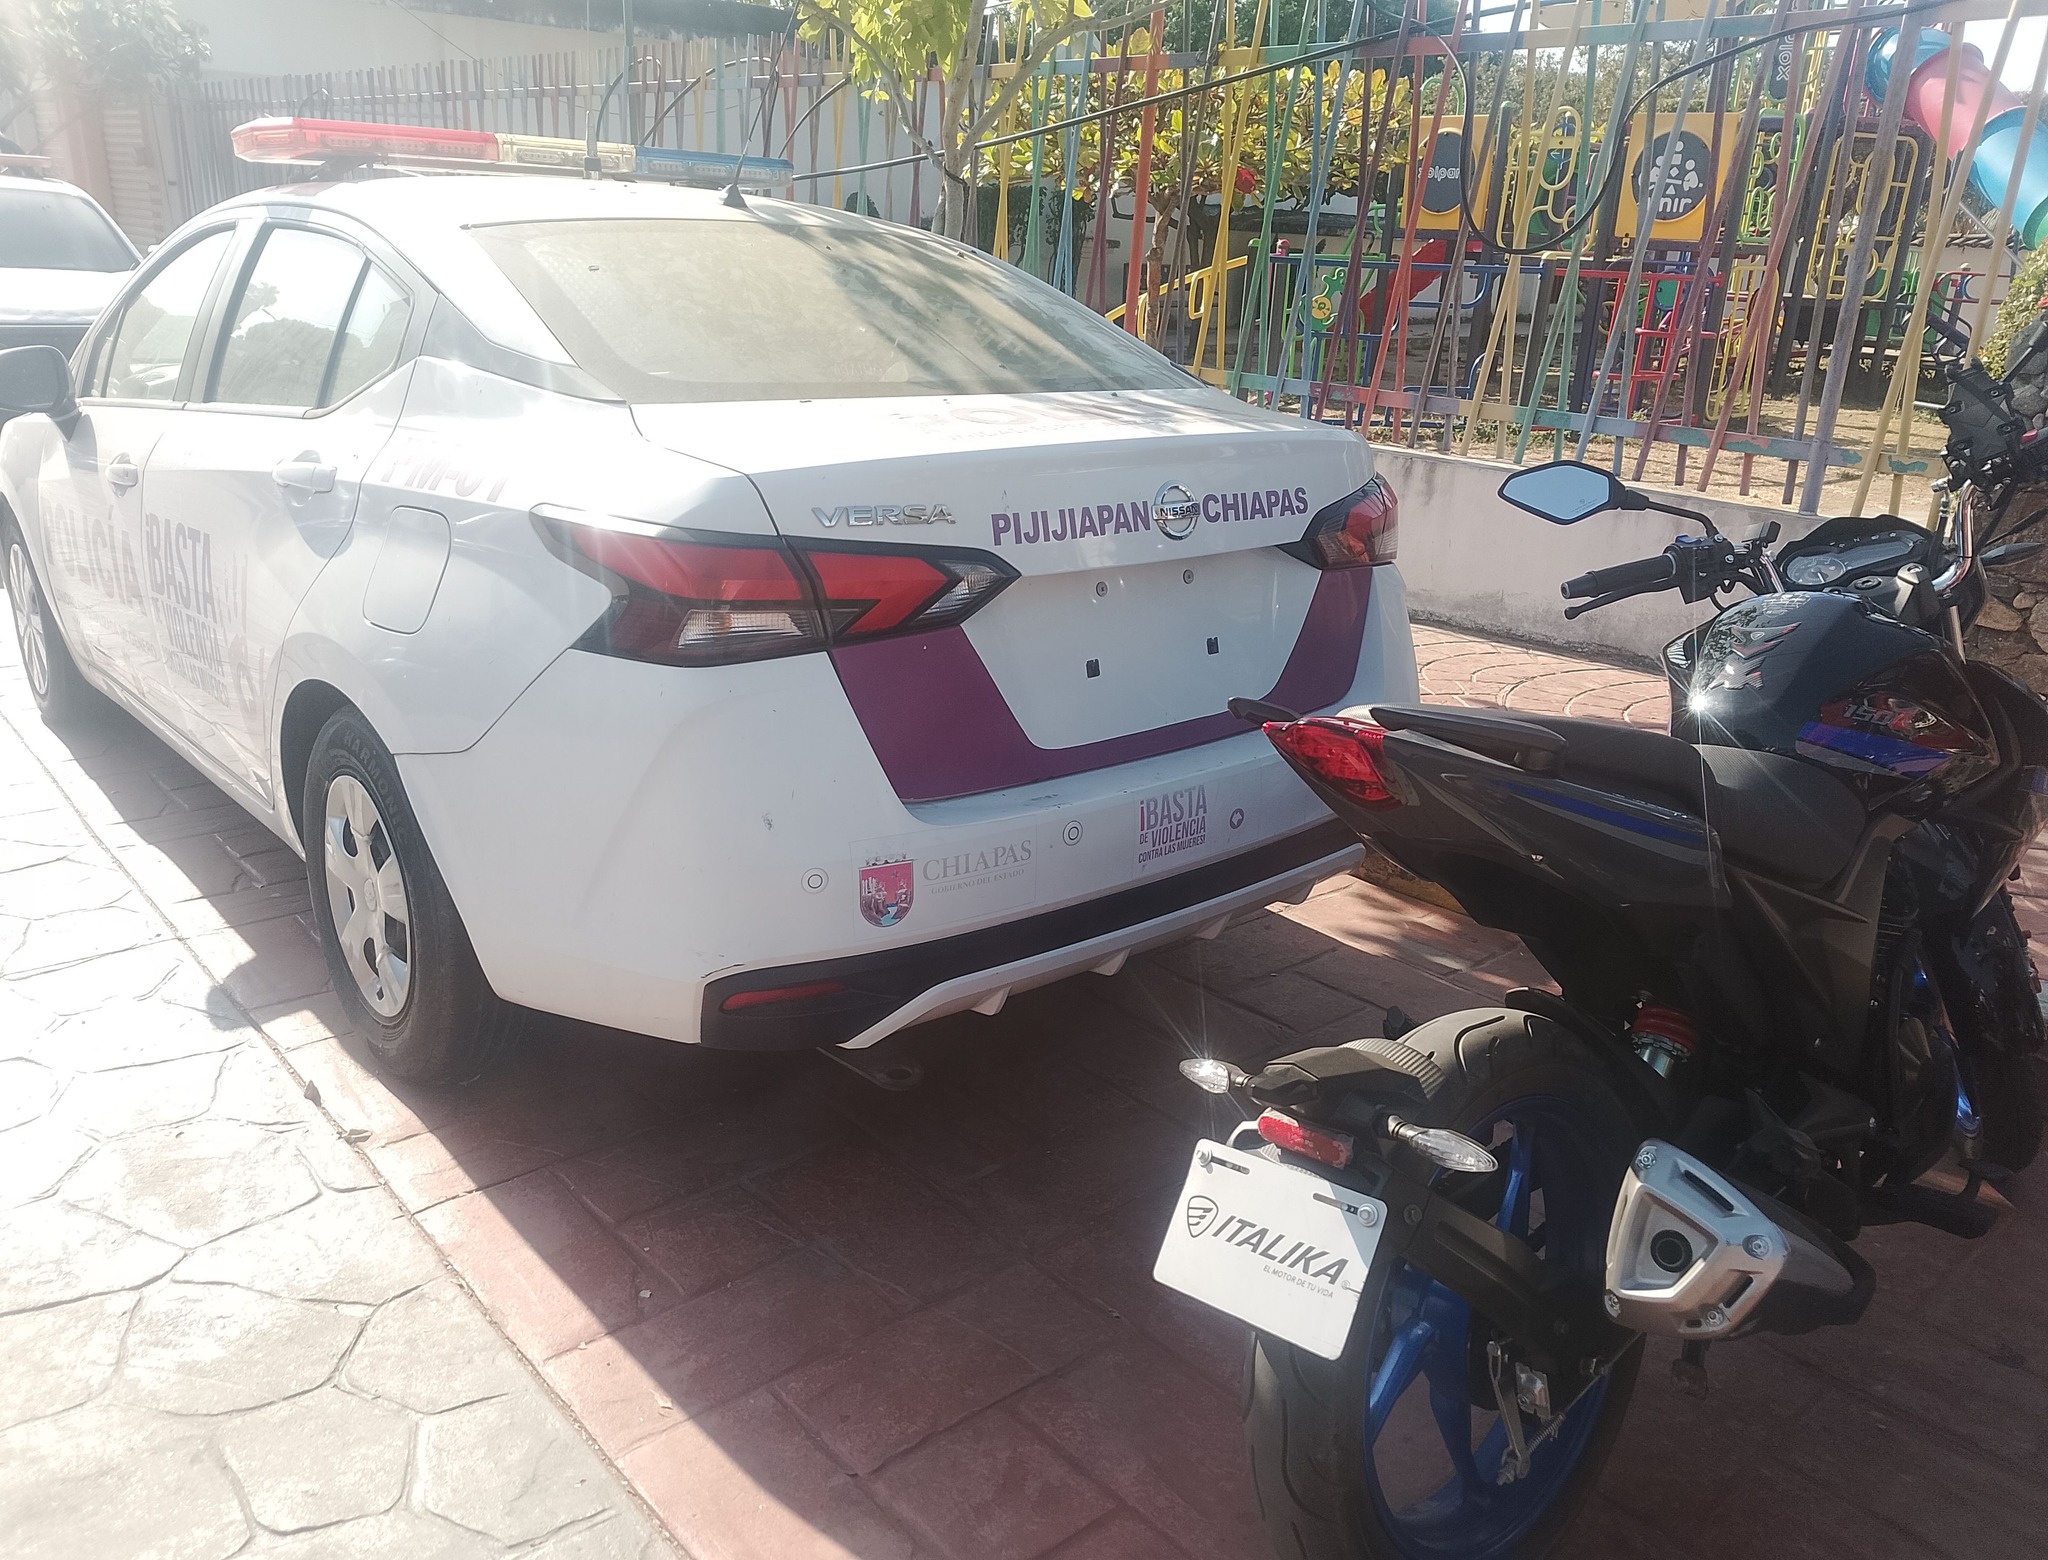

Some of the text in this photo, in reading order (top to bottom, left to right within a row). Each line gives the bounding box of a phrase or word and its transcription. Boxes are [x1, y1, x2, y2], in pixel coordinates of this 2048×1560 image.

[1647, 196, 1692, 213] nir
[811, 503, 957, 528] VERSA
[990, 486, 1309, 546] PIJIJIAPAN CHIAPAS
[1159, 502, 1198, 517] NISSAN
[1139, 816, 1206, 848] DE VIOLENCIA
[922, 840, 1032, 881] CHIAPAS
[1139, 834, 1206, 864] CONTRA LAS MUJERES!
[931, 869, 1025, 895] GOBIERNO DEL ESTADO
[1212, 1215, 1349, 1286] ITALIKA
[1271, 1268, 1297, 1284] MOTOR
[1296, 1278, 1305, 1288] DE
[1306, 1281, 1316, 1291] TU
[1317, 1286, 1334, 1299] VIDA
